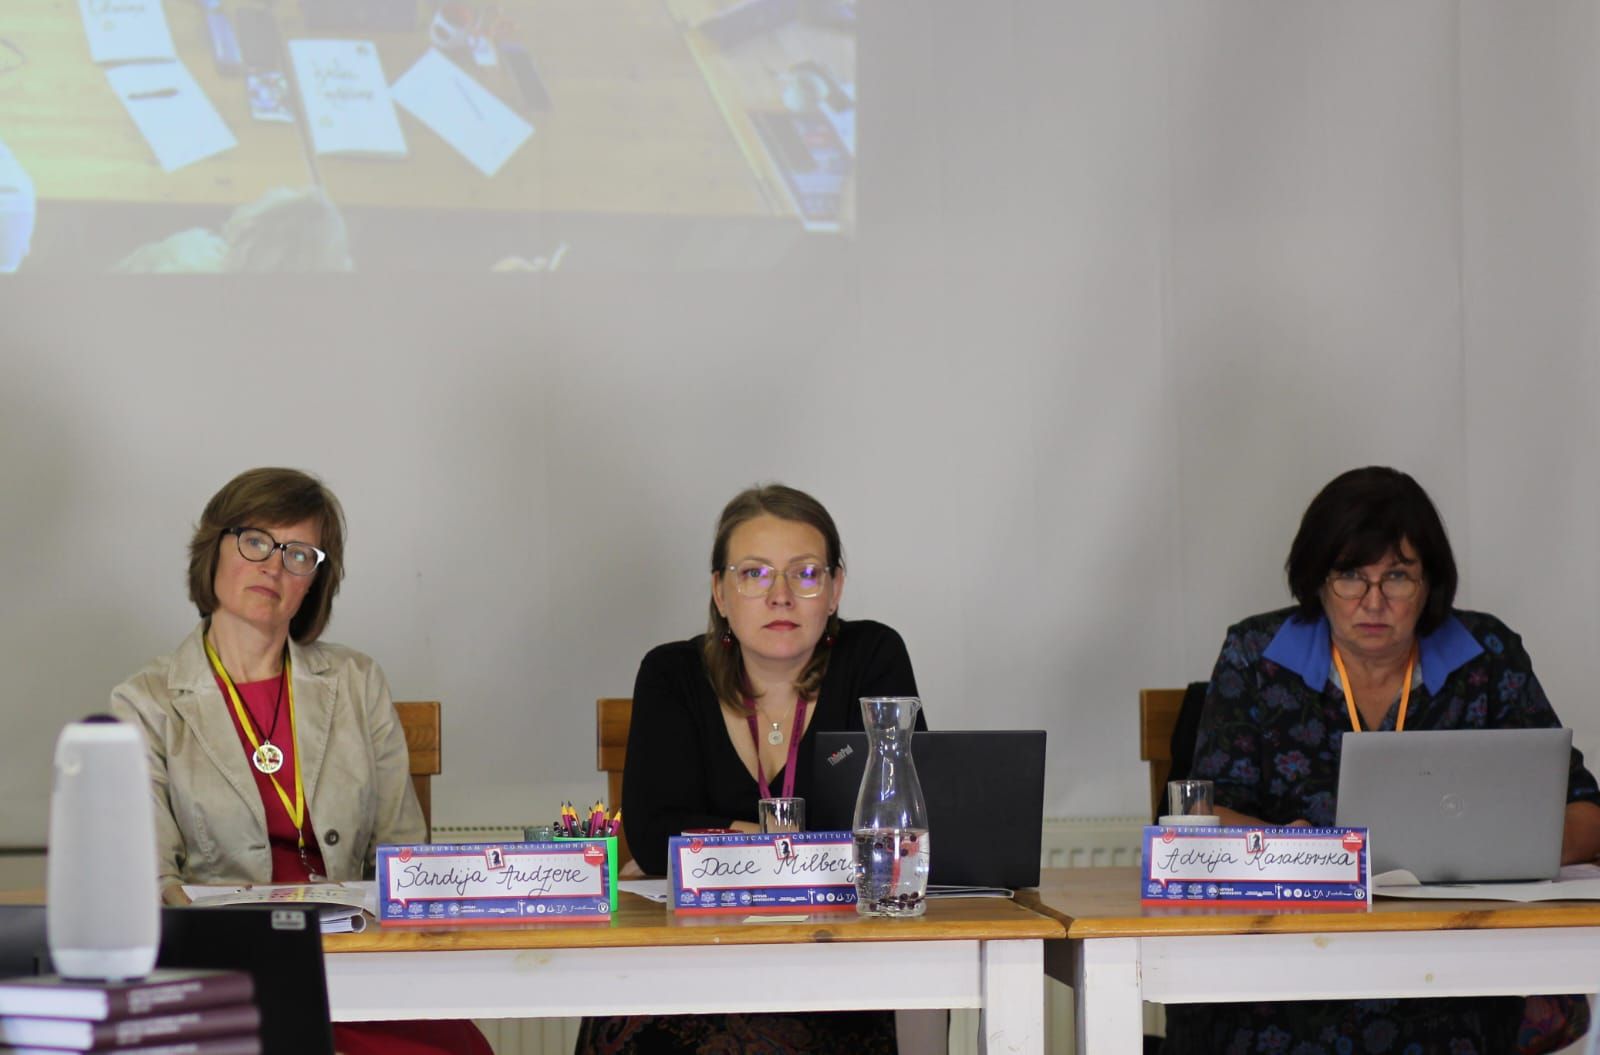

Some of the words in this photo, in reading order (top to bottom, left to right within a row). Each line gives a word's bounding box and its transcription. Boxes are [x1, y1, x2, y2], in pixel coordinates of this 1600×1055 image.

[692, 857, 761, 878] Dace
[1157, 847, 1238, 873] Adrija
[397, 862, 488, 896] Sandija
